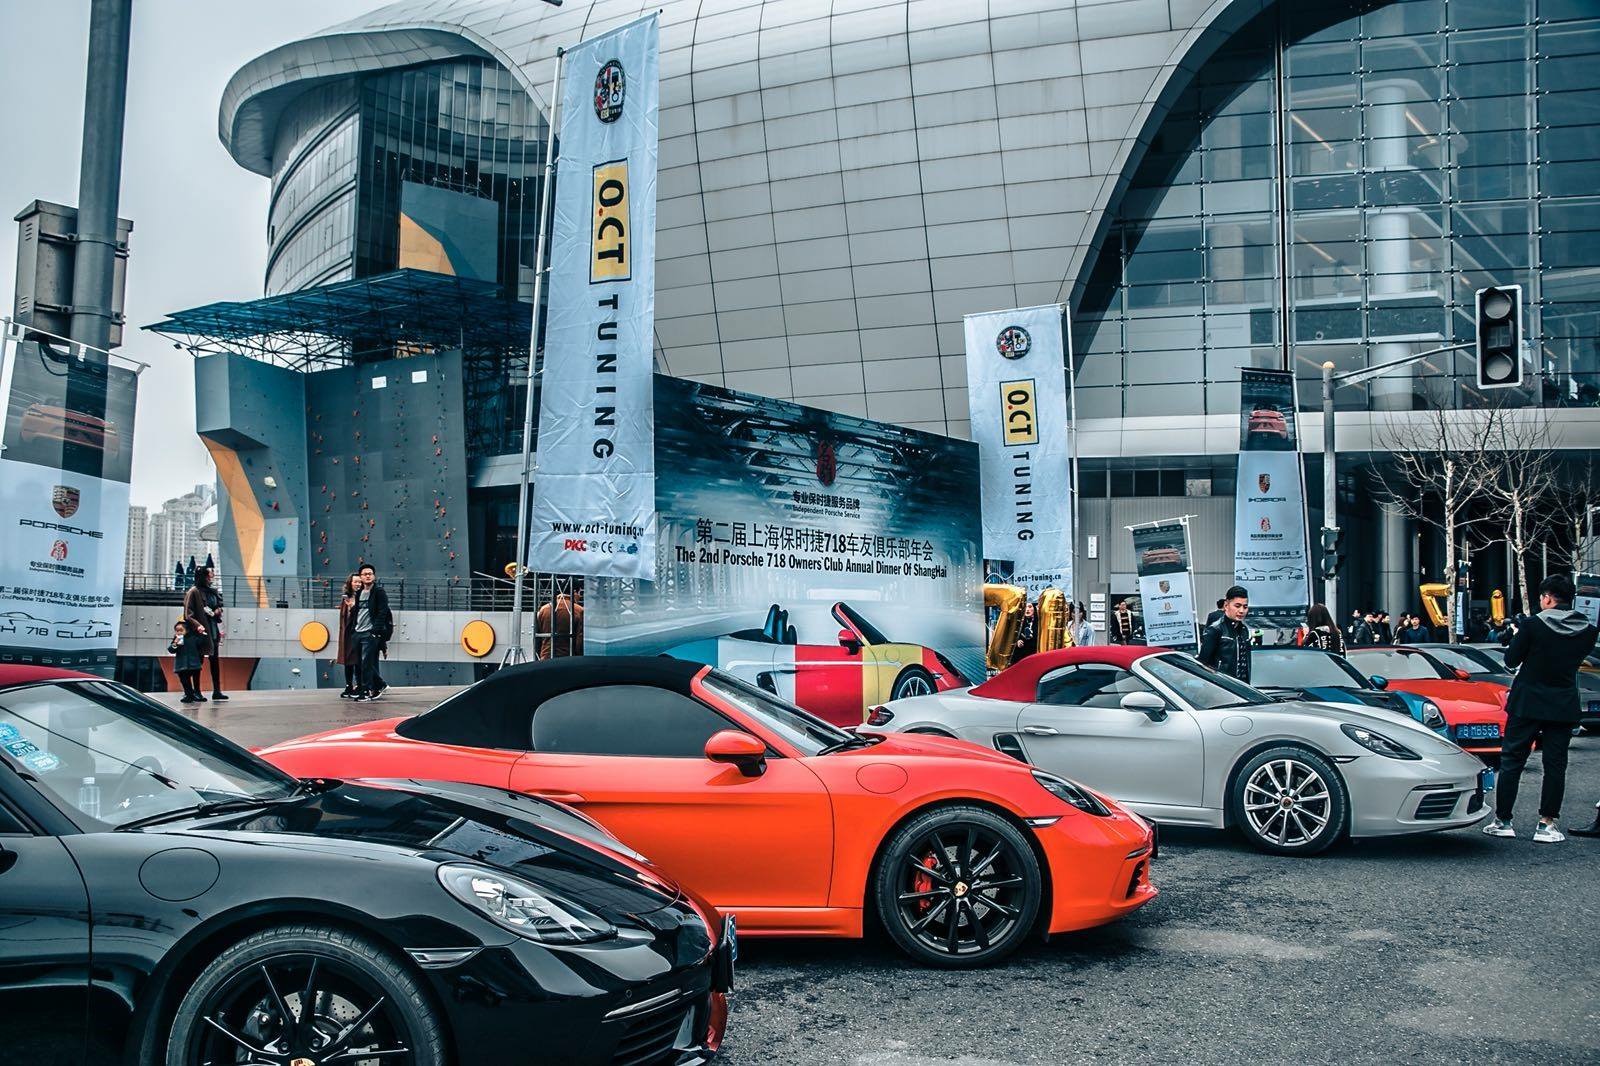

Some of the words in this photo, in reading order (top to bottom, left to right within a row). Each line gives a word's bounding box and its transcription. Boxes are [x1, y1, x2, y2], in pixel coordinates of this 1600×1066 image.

[598, 179, 625, 264] O.CT
[593, 293, 619, 459] TUNING
[793, 490, 861, 511] 专业保时捷服务品牌
[1012, 451, 1034, 541] TUNING
[793, 504, 824, 515] Independent
[825, 508, 844, 518] Porsche
[844, 511, 861, 520] Service
[19, 519, 104, 539] PORSCHE
[695, 518, 934, 562] 第二届上海保时捷718车友俱乐部年会
[564, 539, 587, 552] PICC
[675, 546, 696, 563] The
[699, 548, 720, 564] 2nd
[723, 549, 764, 567] Porsche
[766, 553, 786, 568] 718
[846, 558, 874, 574] Annual
[876, 560, 902, 576] Dinner
[903, 562, 913, 576] Of
[913, 563, 948, 580] ShangHai
[26, 626, 49, 636] 718
[56, 630, 113, 639] CLUB
